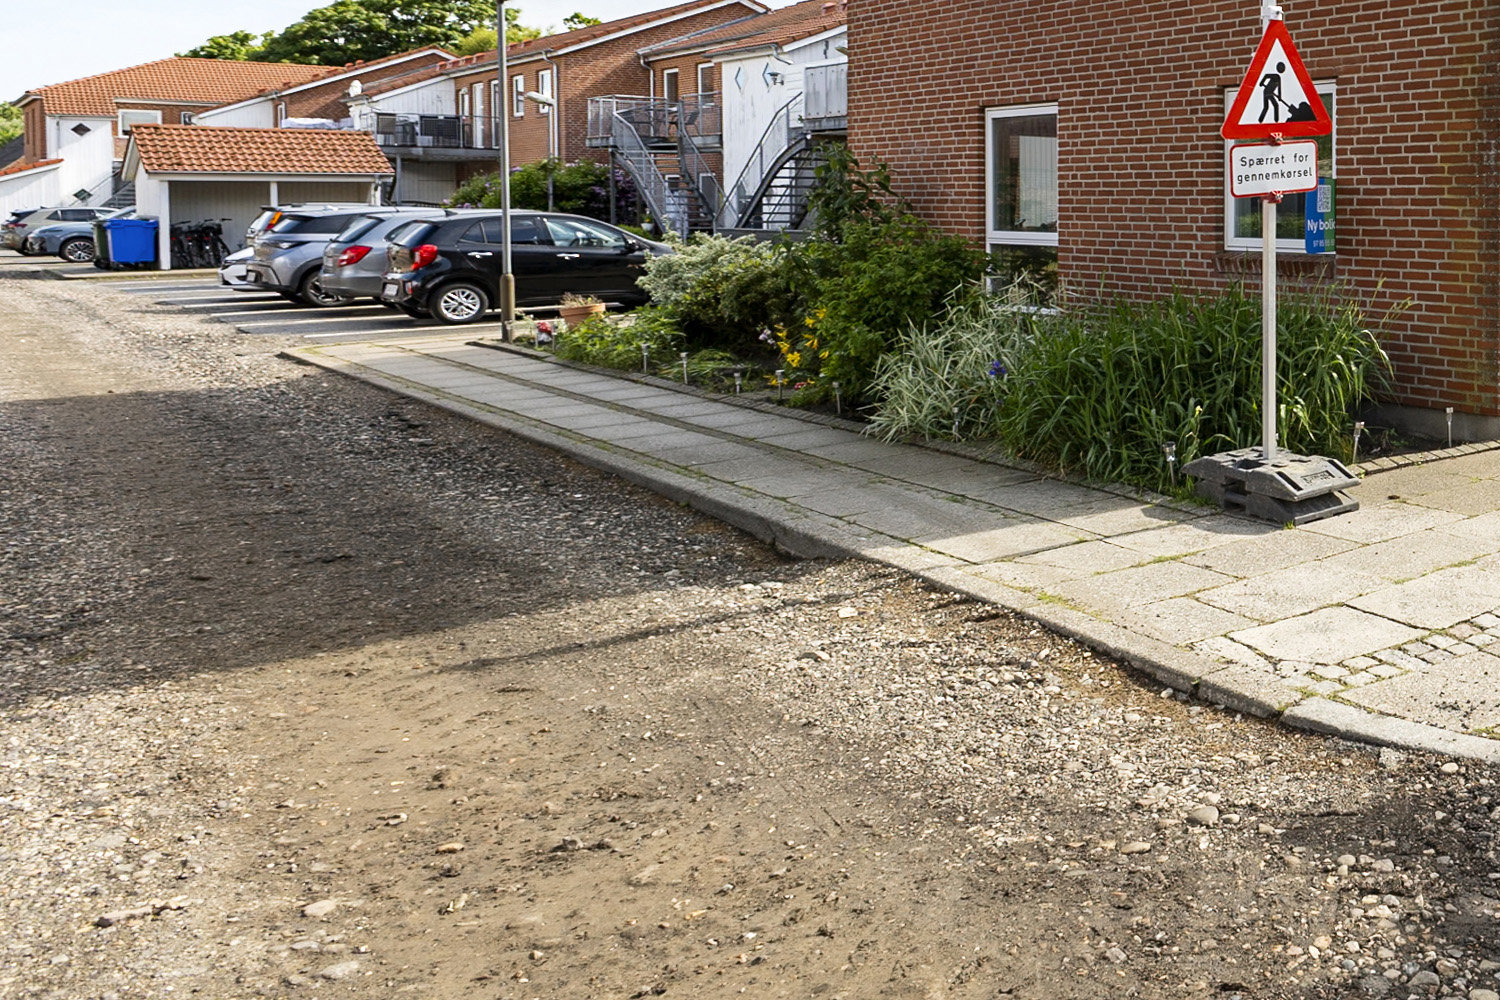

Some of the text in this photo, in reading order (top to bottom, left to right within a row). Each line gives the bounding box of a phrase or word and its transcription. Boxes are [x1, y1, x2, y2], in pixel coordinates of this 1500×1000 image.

[1240, 153, 1308, 167] Spærret for
[1237, 168, 1312, 184] gennemkørsel
[1307, 219, 1318, 234] Ny
